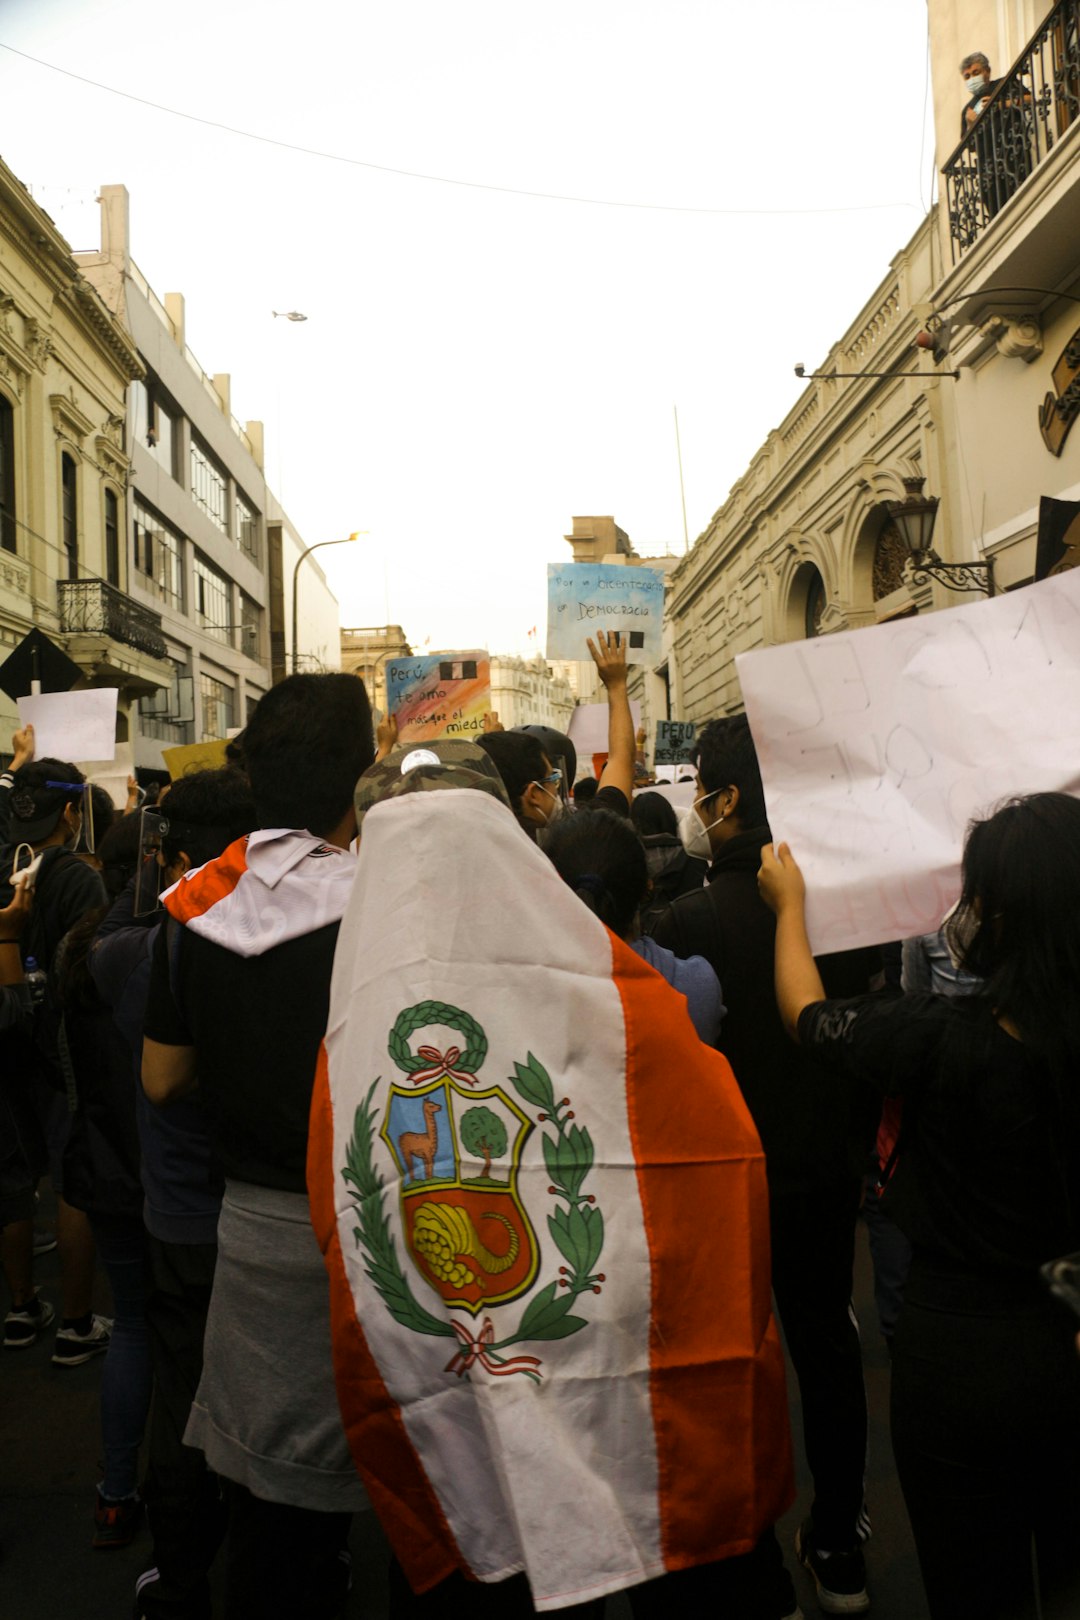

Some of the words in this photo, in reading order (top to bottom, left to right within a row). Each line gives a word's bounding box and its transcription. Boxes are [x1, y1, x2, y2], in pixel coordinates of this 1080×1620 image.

[555, 576, 573, 587] Por
[390, 663, 426, 683] Perú,
[395, 690, 414, 704] te
[419, 688, 447, 701] amo
[428, 712, 447, 726] que
[453, 708, 463, 720] el
